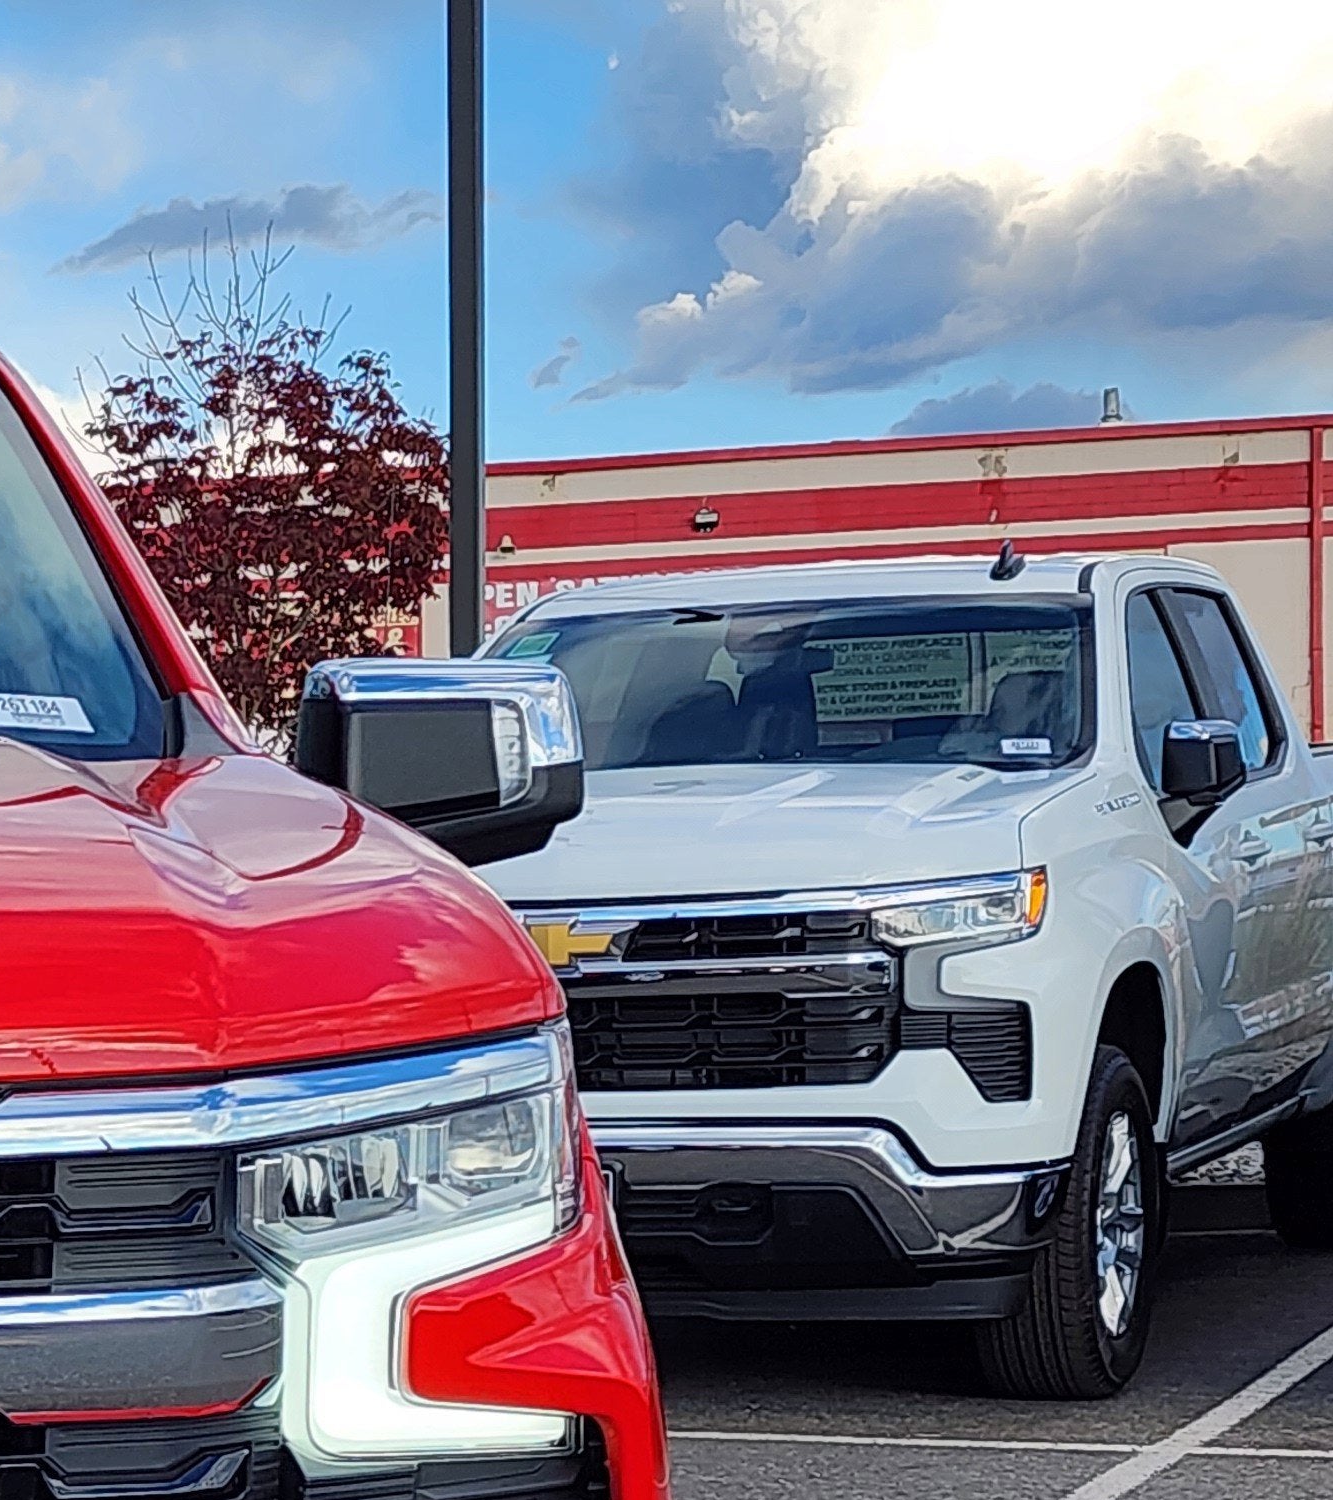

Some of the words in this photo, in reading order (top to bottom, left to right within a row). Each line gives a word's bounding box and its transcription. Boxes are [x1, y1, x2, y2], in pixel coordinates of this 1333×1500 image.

[483, 580, 539, 609] PEN
[852, 641, 889, 651] WOOD
[891, 637, 963, 648] FIREPLACES
